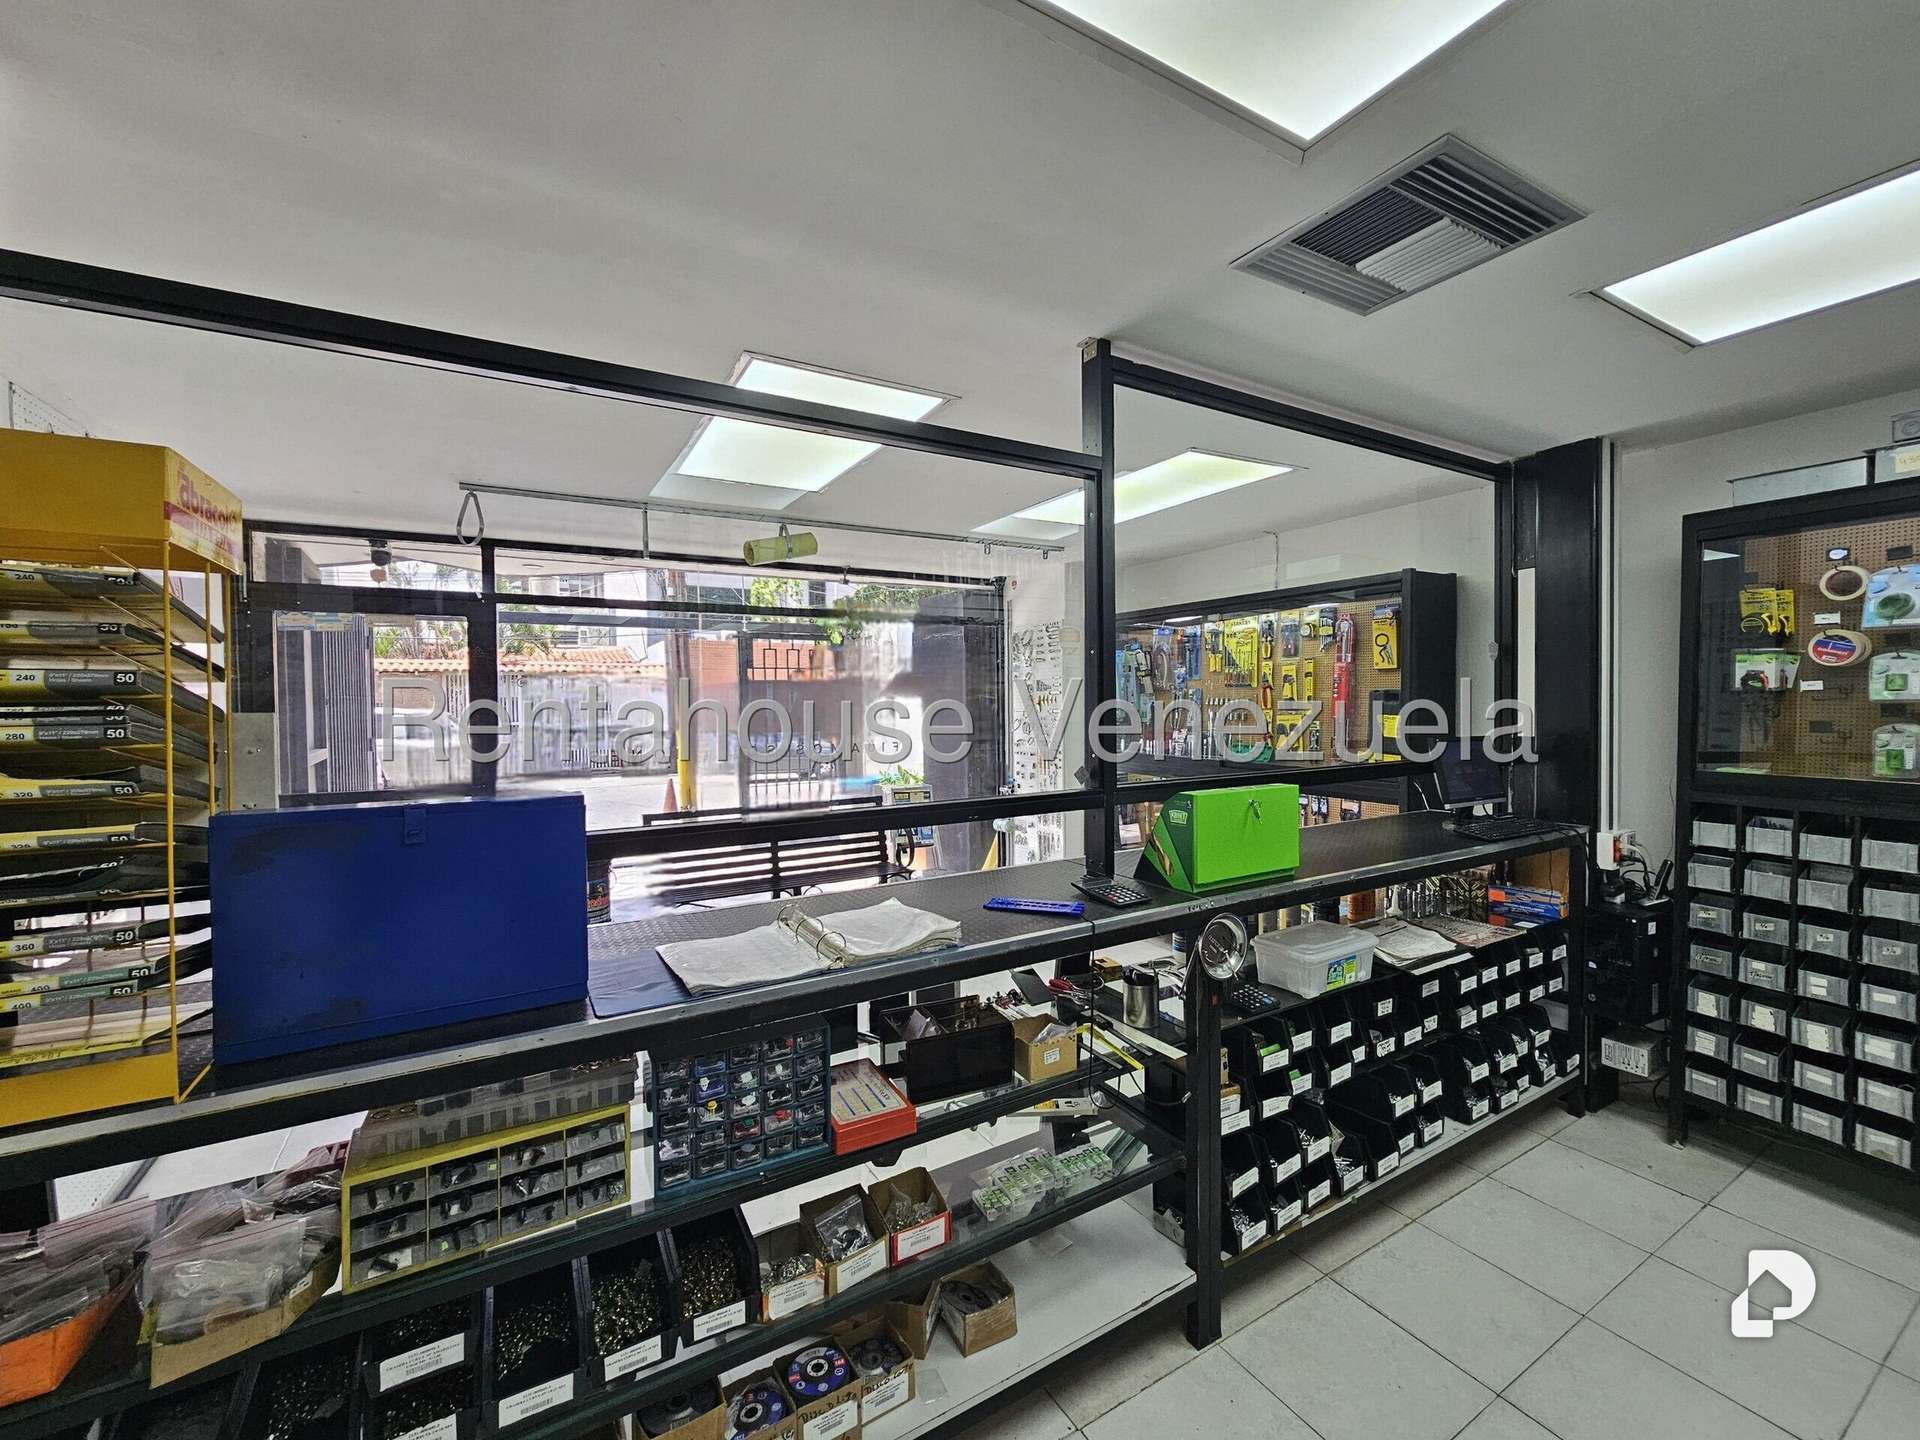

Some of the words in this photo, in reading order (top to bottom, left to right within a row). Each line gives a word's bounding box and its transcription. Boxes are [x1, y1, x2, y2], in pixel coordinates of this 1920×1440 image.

[116, 673, 136, 683] 50
[5, 733, 25, 741] 280
[106, 729, 125, 739] 50
[114, 786, 133, 795] 50
[15, 943, 35, 952] 360
[116, 931, 134, 941] 50
[131, 968, 149, 977] 50
[113, 987, 131, 996] 50
